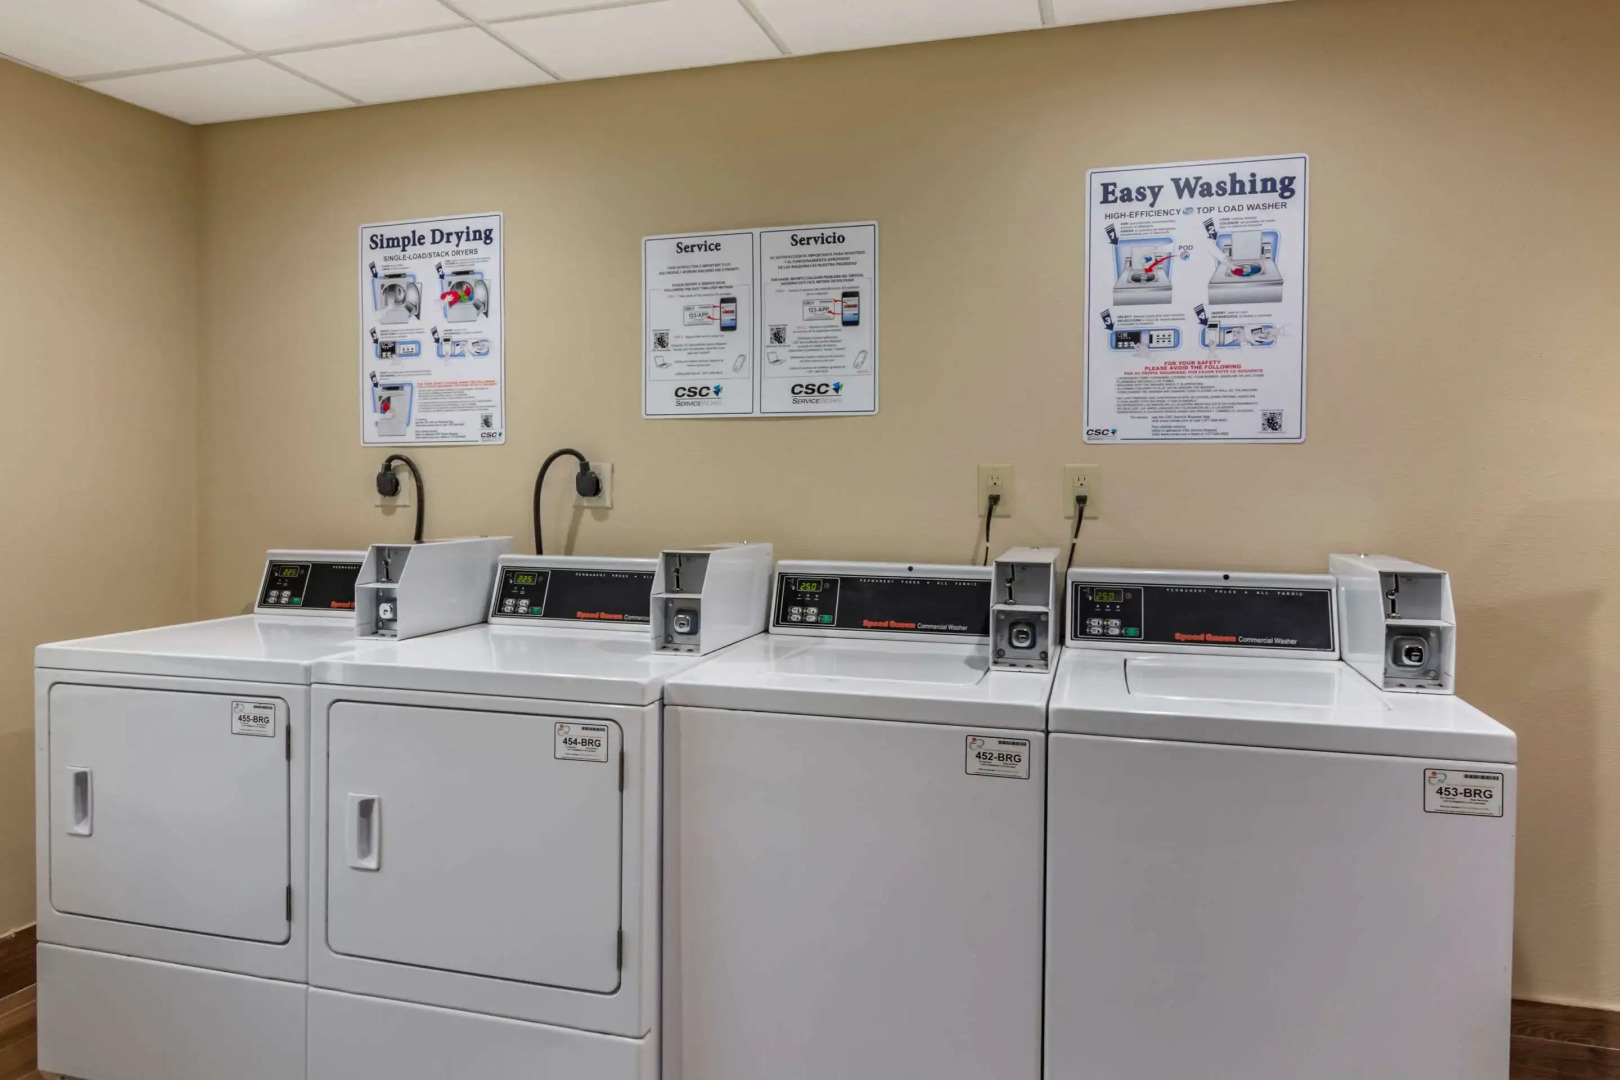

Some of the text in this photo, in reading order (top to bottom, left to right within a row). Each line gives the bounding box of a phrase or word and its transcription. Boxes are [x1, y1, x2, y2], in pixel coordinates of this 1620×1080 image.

[1100, 172, 1296, 208] Easy Washing
[1246, 202, 1287, 211] WASHER
[1104, 209, 1181, 220] HIGH-EFFICIENCY
[370, 226, 494, 252] Simple Drying
[790, 232, 845, 246] Servicio
[676, 241, 721, 254] Service
[383, 248, 478, 262] SINGLE-LOAD/STACK DRYERS
[674, 386, 710, 397] CSC
[791, 383, 830, 395] CSC
[1096, 592, 1115, 600] 250
[917, 623, 947, 631] Commercial
[1238, 636, 1273, 644] Commercial
[1274, 637, 1297, 645] Washer
[238, 715, 270, 724] 455-BRG
[562, 737, 601, 747] 454-BRG
[975, 751, 1022, 763] 452-BRG
[1436, 787, 1493, 799] 453-BRG
